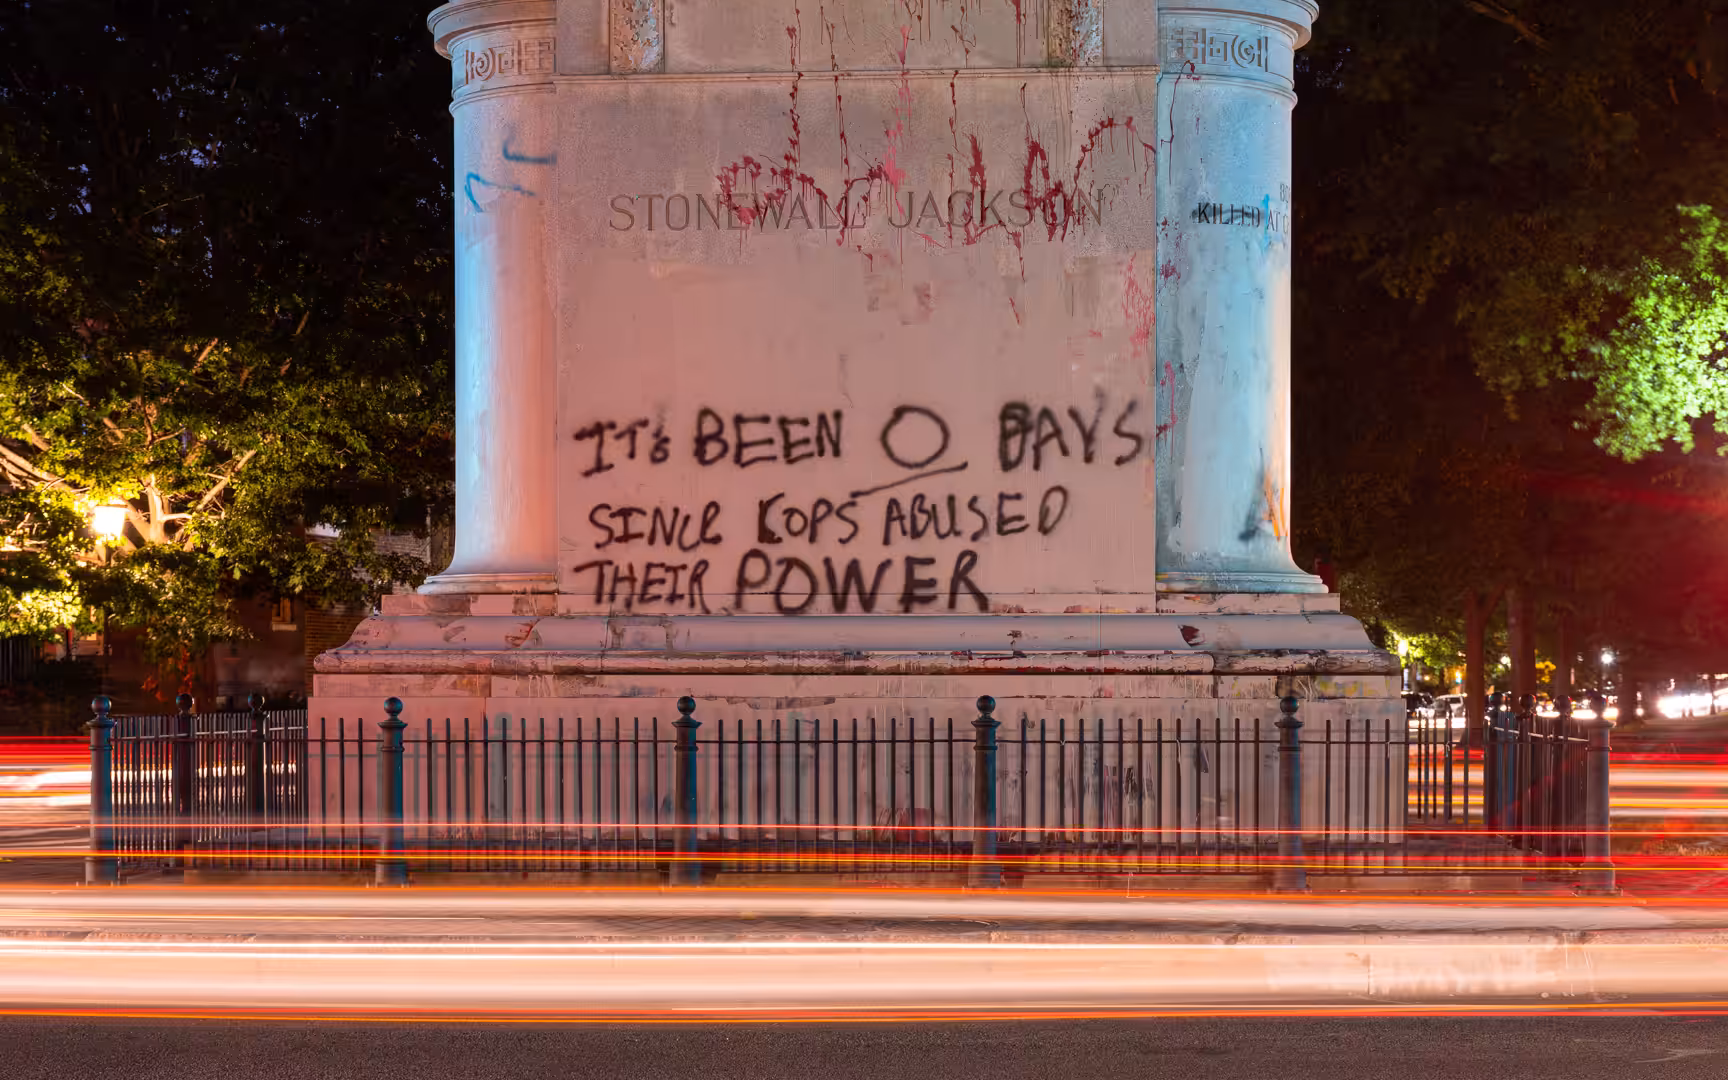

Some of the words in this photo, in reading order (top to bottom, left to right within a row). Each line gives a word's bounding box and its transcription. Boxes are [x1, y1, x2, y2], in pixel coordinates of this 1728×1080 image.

[609, 193, 867, 232] STONEWALL
[888, 188, 1101, 228] JACKSON
[693, 407, 843, 467] BEEN
[883, 486, 1068, 545] ABUSED
[573, 558, 711, 614] THEIR
[735, 548, 991, 614] POWER
